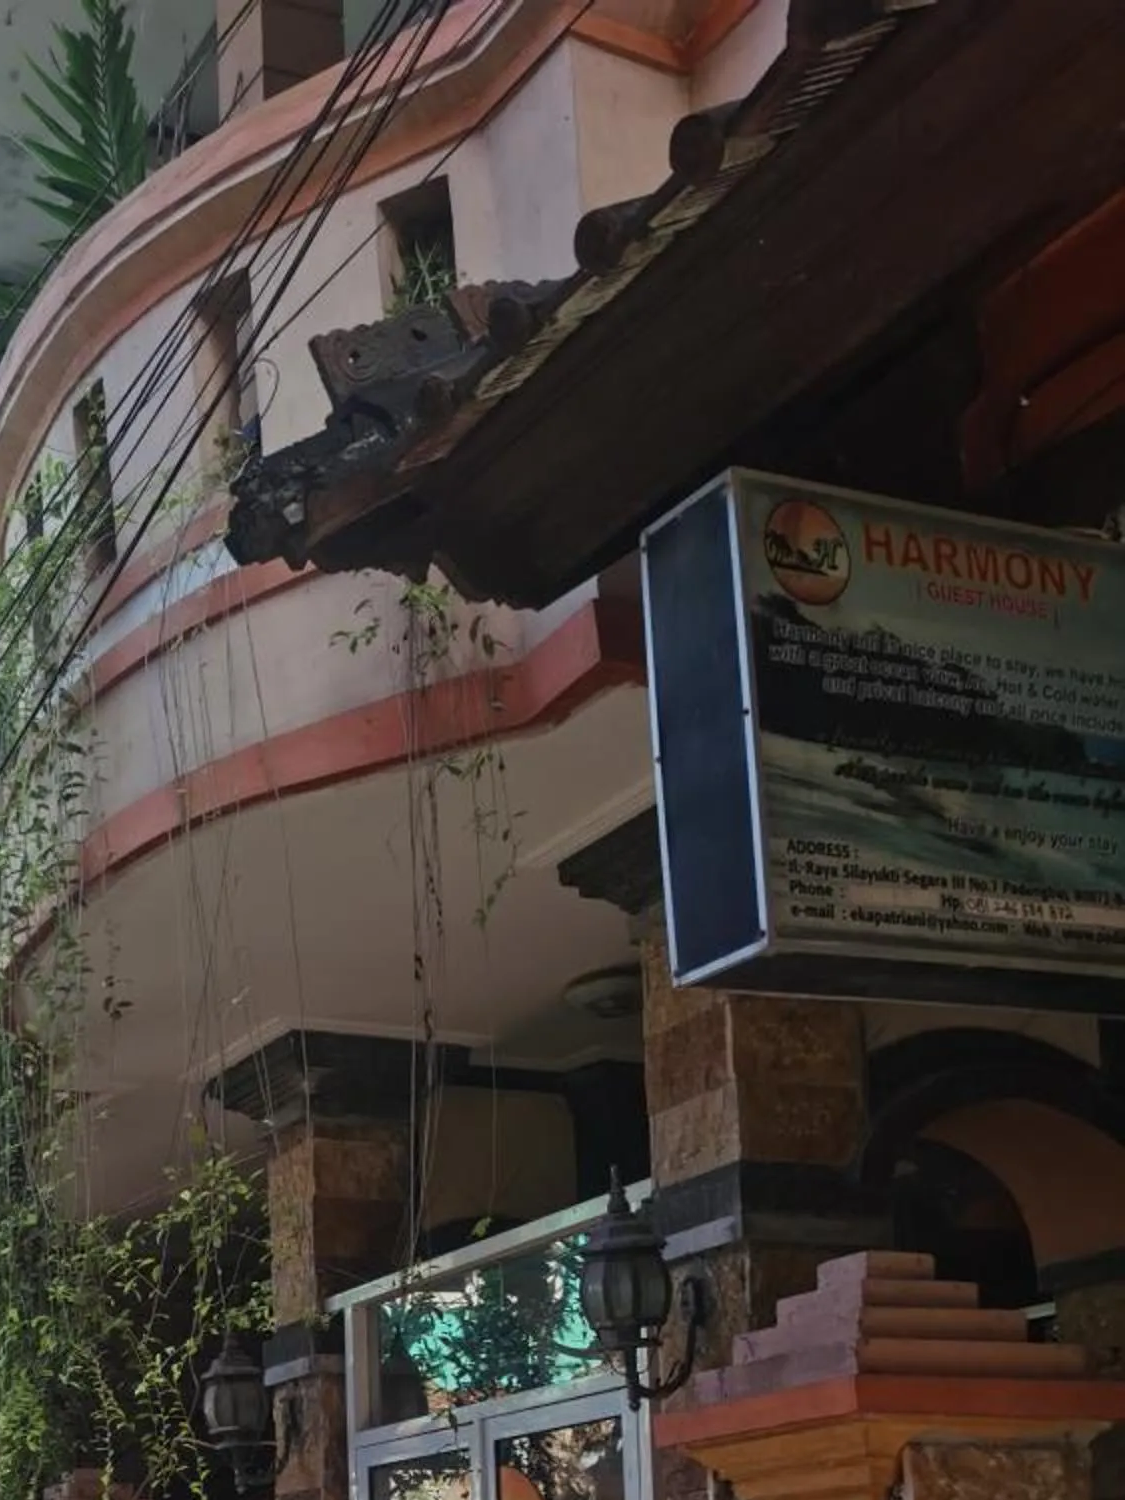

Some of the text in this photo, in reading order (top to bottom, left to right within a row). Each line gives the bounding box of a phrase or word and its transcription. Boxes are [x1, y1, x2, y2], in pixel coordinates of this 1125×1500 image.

[862, 521, 1098, 603] HARMONY
[927, 581, 1050, 619] GUEST HOUSE
[903, 641, 936, 661] nice
[940, 646, 982, 665] place
[986, 654, 1002, 670] to
[1070, 668, 1104, 685] have
[996, 678, 1022, 697] Hot
[1027, 683, 1038, 698] &
[1042, 685, 1077, 704] Cold
[1009, 702, 1026, 717] all
[1030, 707, 1067, 725] price
[786, 838, 850, 859] ADDRESS
[1004, 827, 1045, 848] enjoy
[1050, 831, 1083, 849] your
[1088, 834, 1118, 856] stay
[789, 879, 833, 897] Phone
[903, 869, 948, 890] Segara
[790, 902, 835, 920] e-mail
